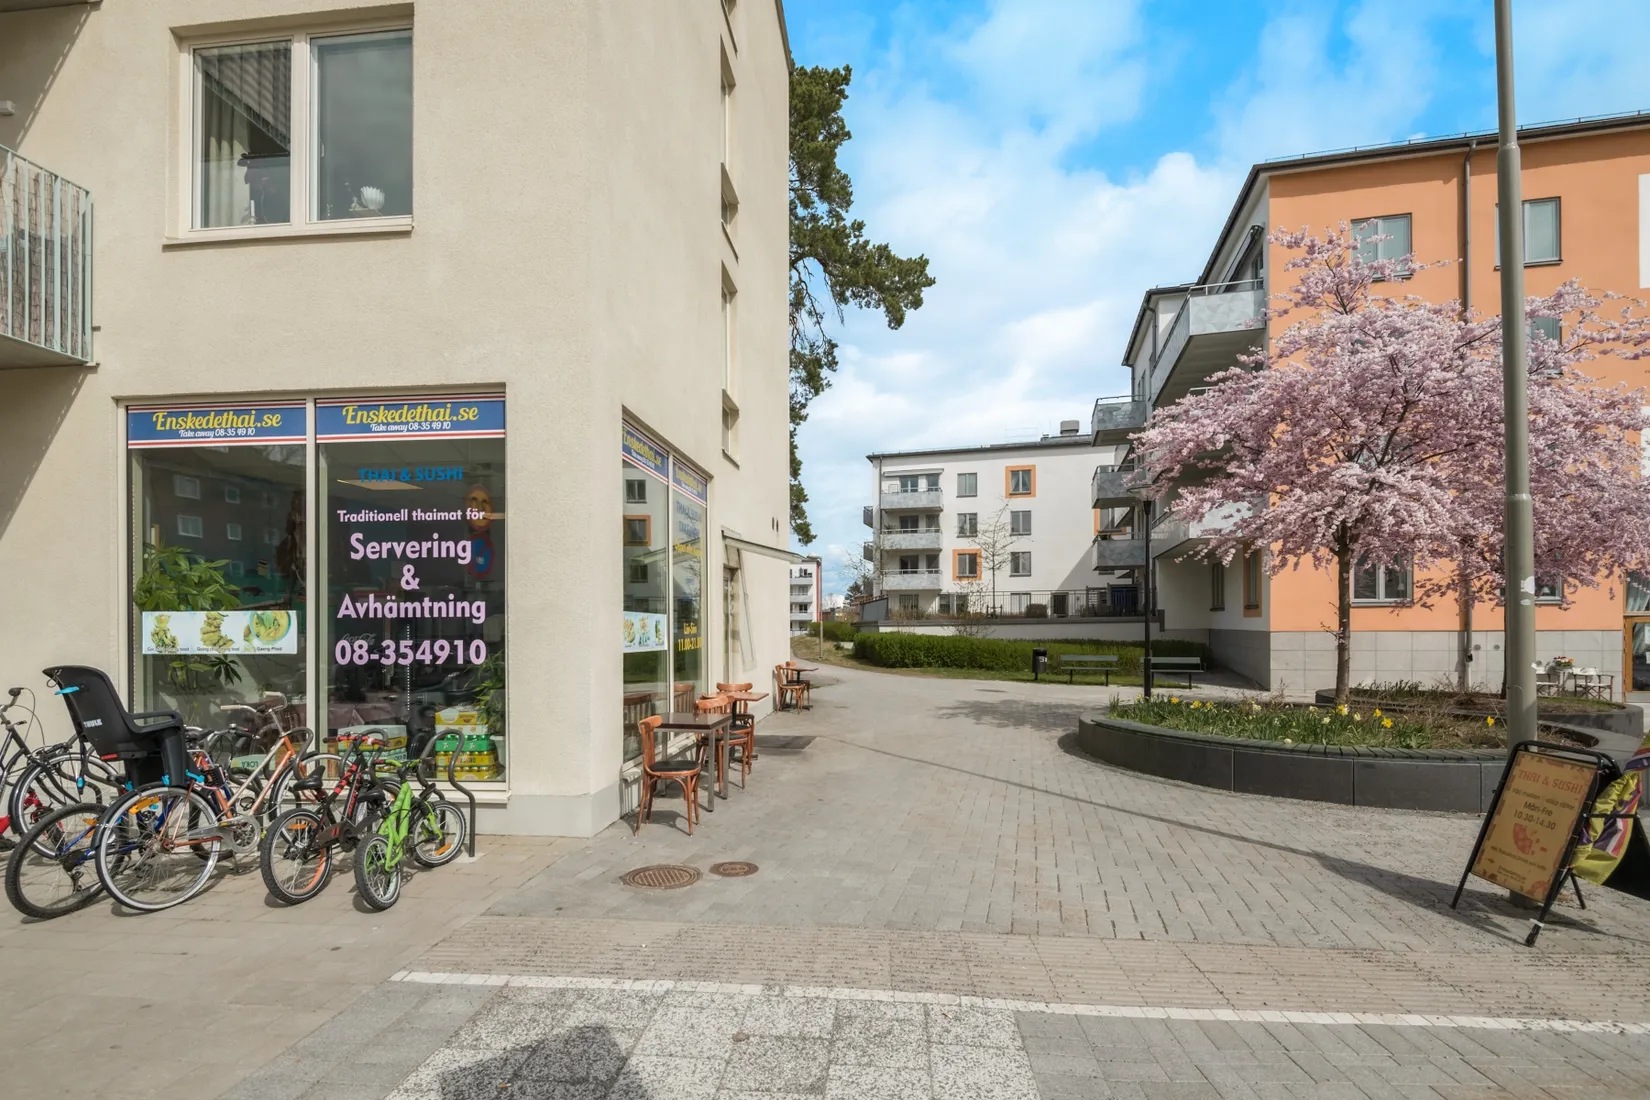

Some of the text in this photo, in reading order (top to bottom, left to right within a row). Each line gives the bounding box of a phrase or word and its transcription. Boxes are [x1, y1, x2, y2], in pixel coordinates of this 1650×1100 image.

[152, 410, 282, 431] Enskedethai.se
[342, 404, 480, 424] Enskedethai.se
[178, 427, 256, 439] Take away 08-35 49 10
[370, 420, 451, 433] Take away 08-35 49 10
[358, 466, 464, 483] THAI & SUSHI
[336, 507, 486, 523] Traditionell thaimat för
[350, 532, 472, 565] Servering
[400, 564, 420, 590] &
[336, 593, 486, 625] Avhämtning
[334, 639, 487, 666] 08-354910
[1518, 769, 1584, 795] THAI & SUSHI
[1513, 808, 1557, 831] 10.30-14.30
[1523, 801, 1554, 817] Mån-Fre
